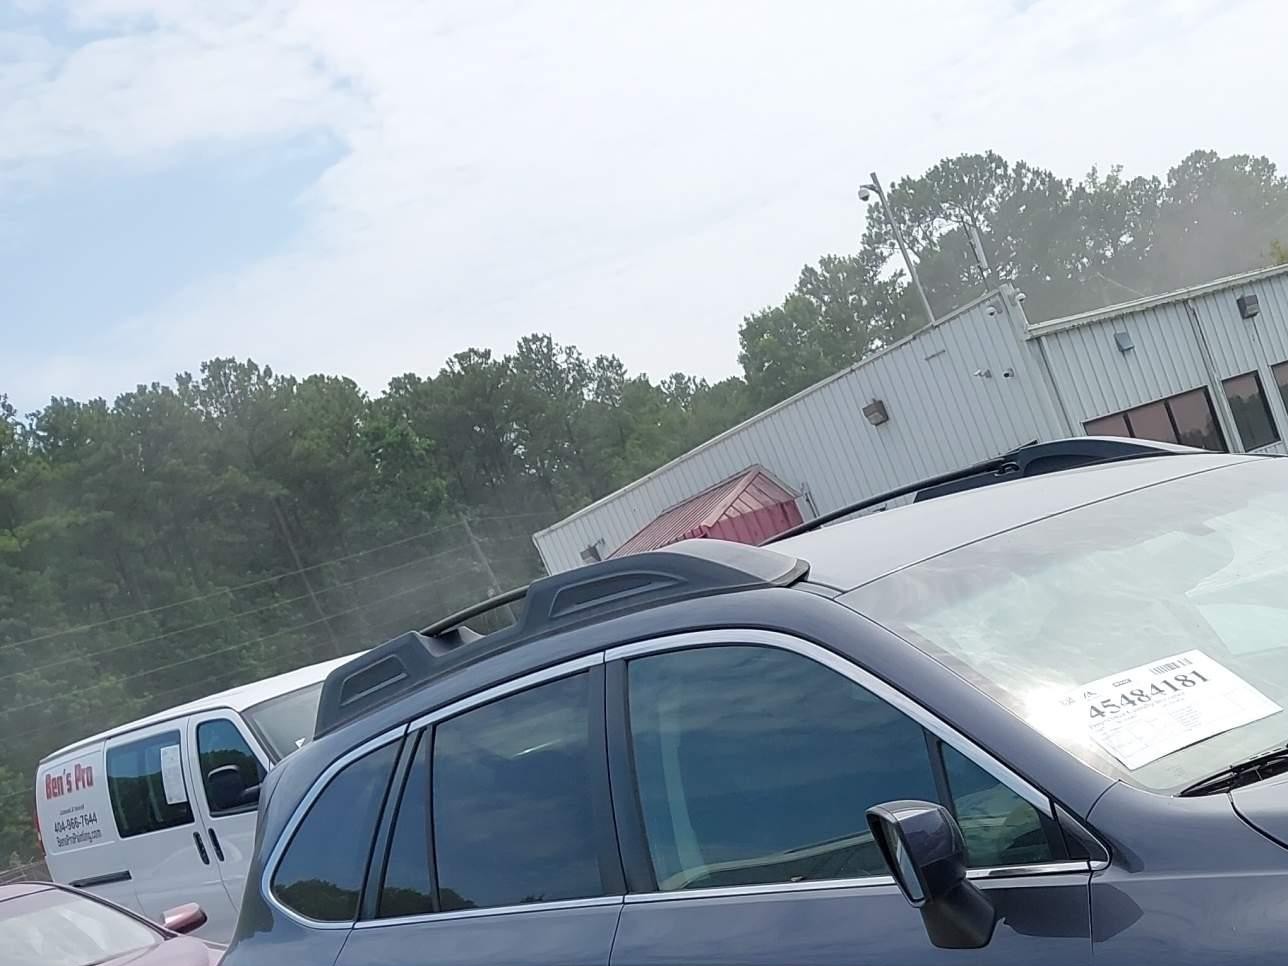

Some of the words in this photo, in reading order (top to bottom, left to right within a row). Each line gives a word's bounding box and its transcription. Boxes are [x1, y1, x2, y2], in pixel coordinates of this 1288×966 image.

[1089, 669, 1209, 719] 45484181
[45, 768, 73, 800] Ben's
[74, 763, 95, 791] Pro
[54, 811, 99, 833] 404-966-7644
